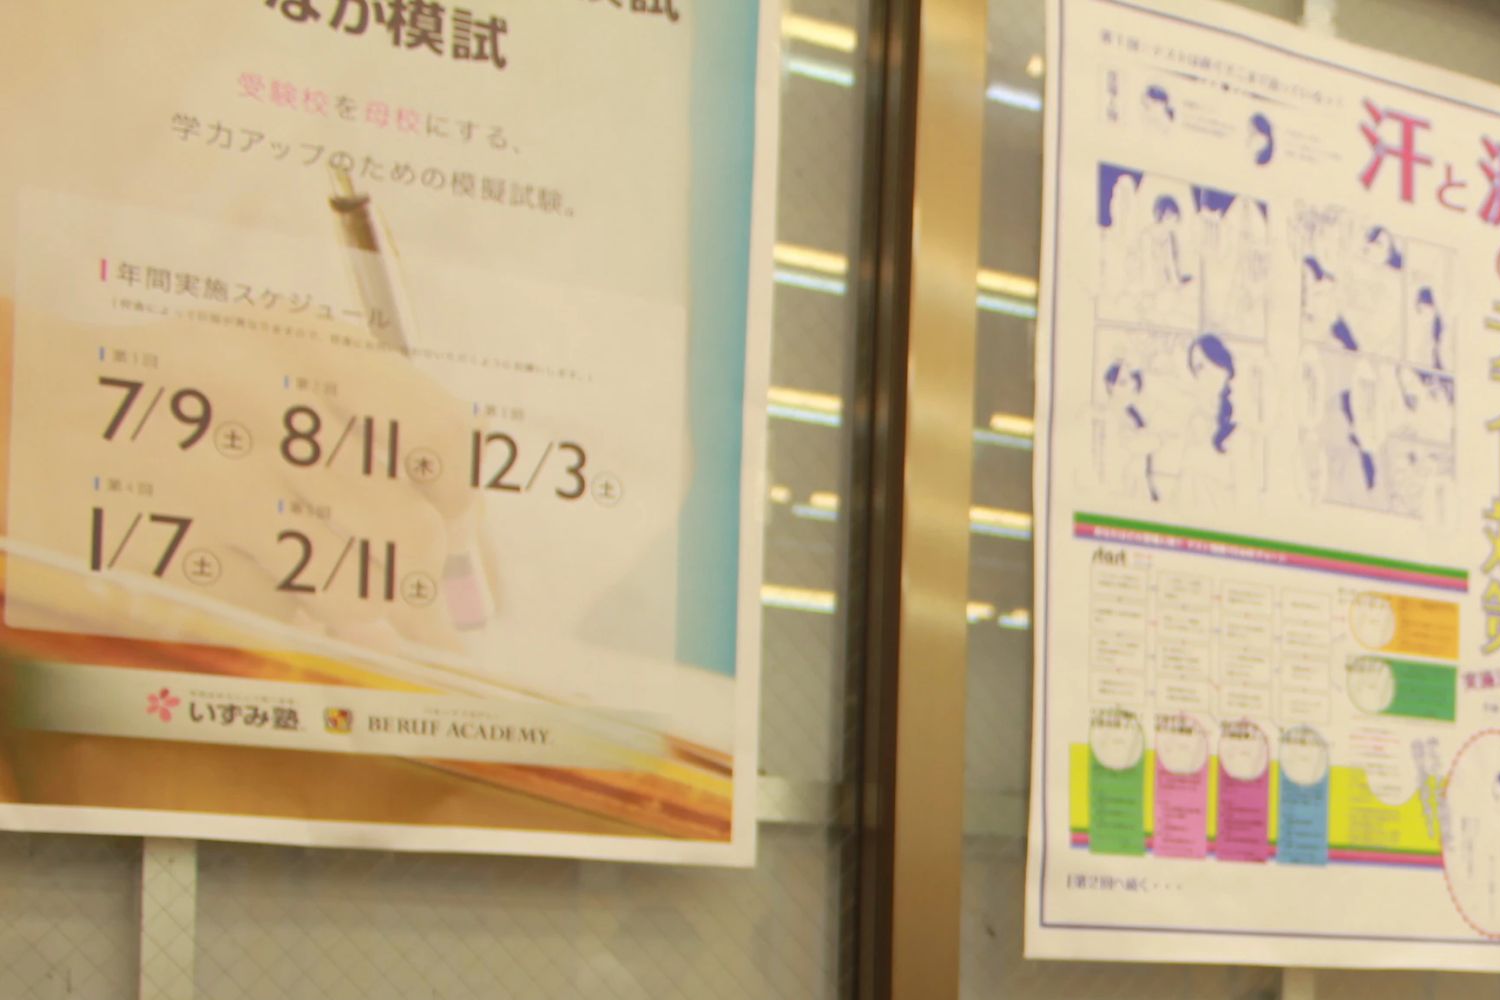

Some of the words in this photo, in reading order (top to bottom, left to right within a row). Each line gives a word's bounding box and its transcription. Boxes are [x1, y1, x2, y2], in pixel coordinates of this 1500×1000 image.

[117, 262, 392, 330] 年間実施スケジュール
[189, 701, 299, 732] いずみ塾
[446, 716, 550, 745] ACADEMY
